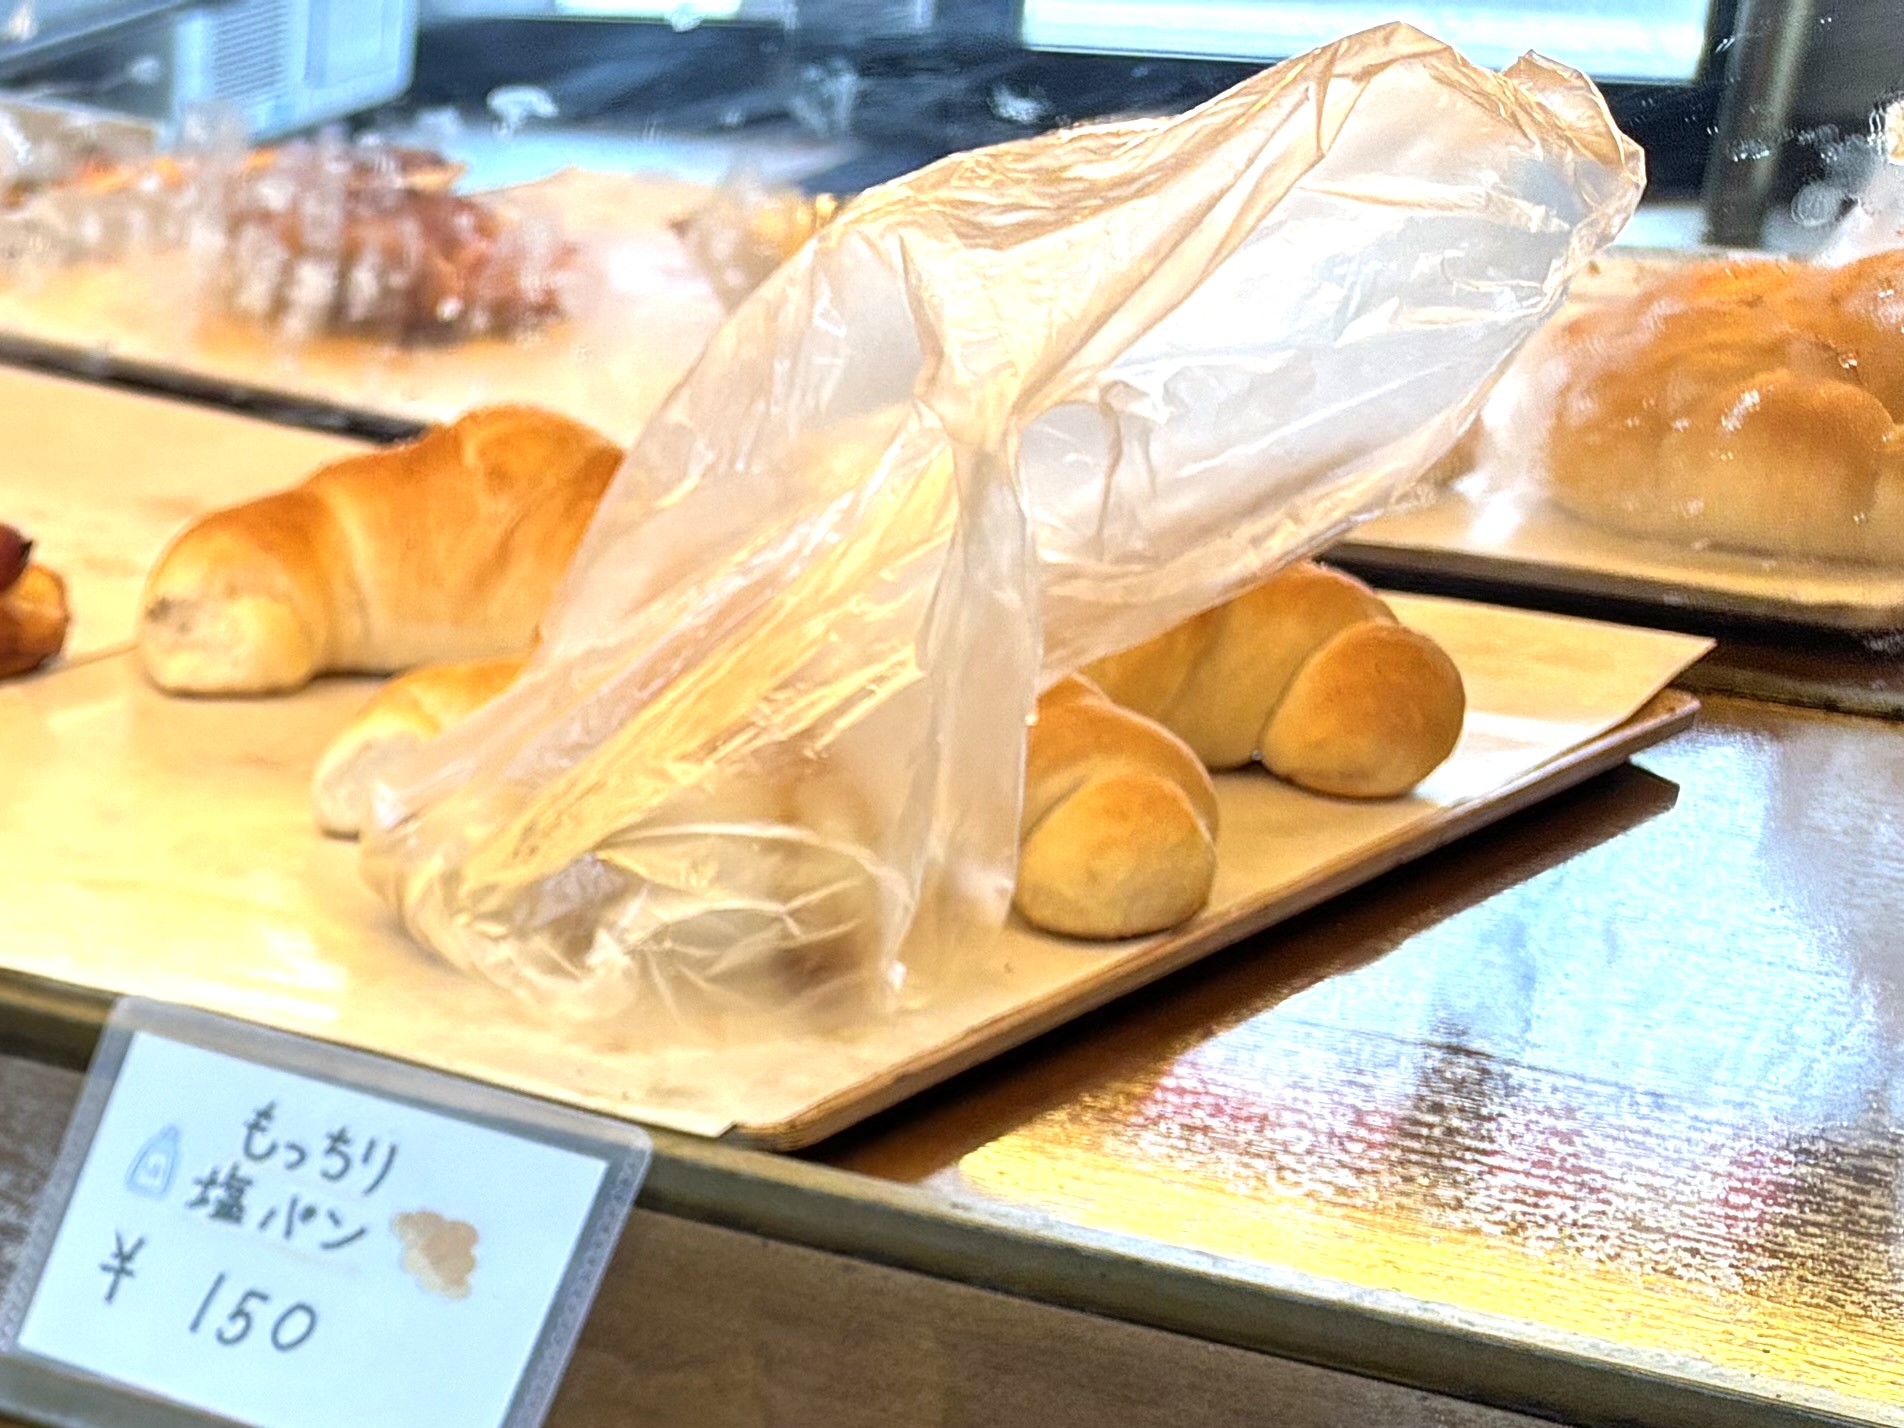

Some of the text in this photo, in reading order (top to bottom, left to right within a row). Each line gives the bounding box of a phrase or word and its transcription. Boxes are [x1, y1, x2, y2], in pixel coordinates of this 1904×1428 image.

[241, 1099, 398, 1195] もっちり
[185, 1160, 368, 1252] 塩パン
[98, 1229, 319, 1353] ¥ 150
